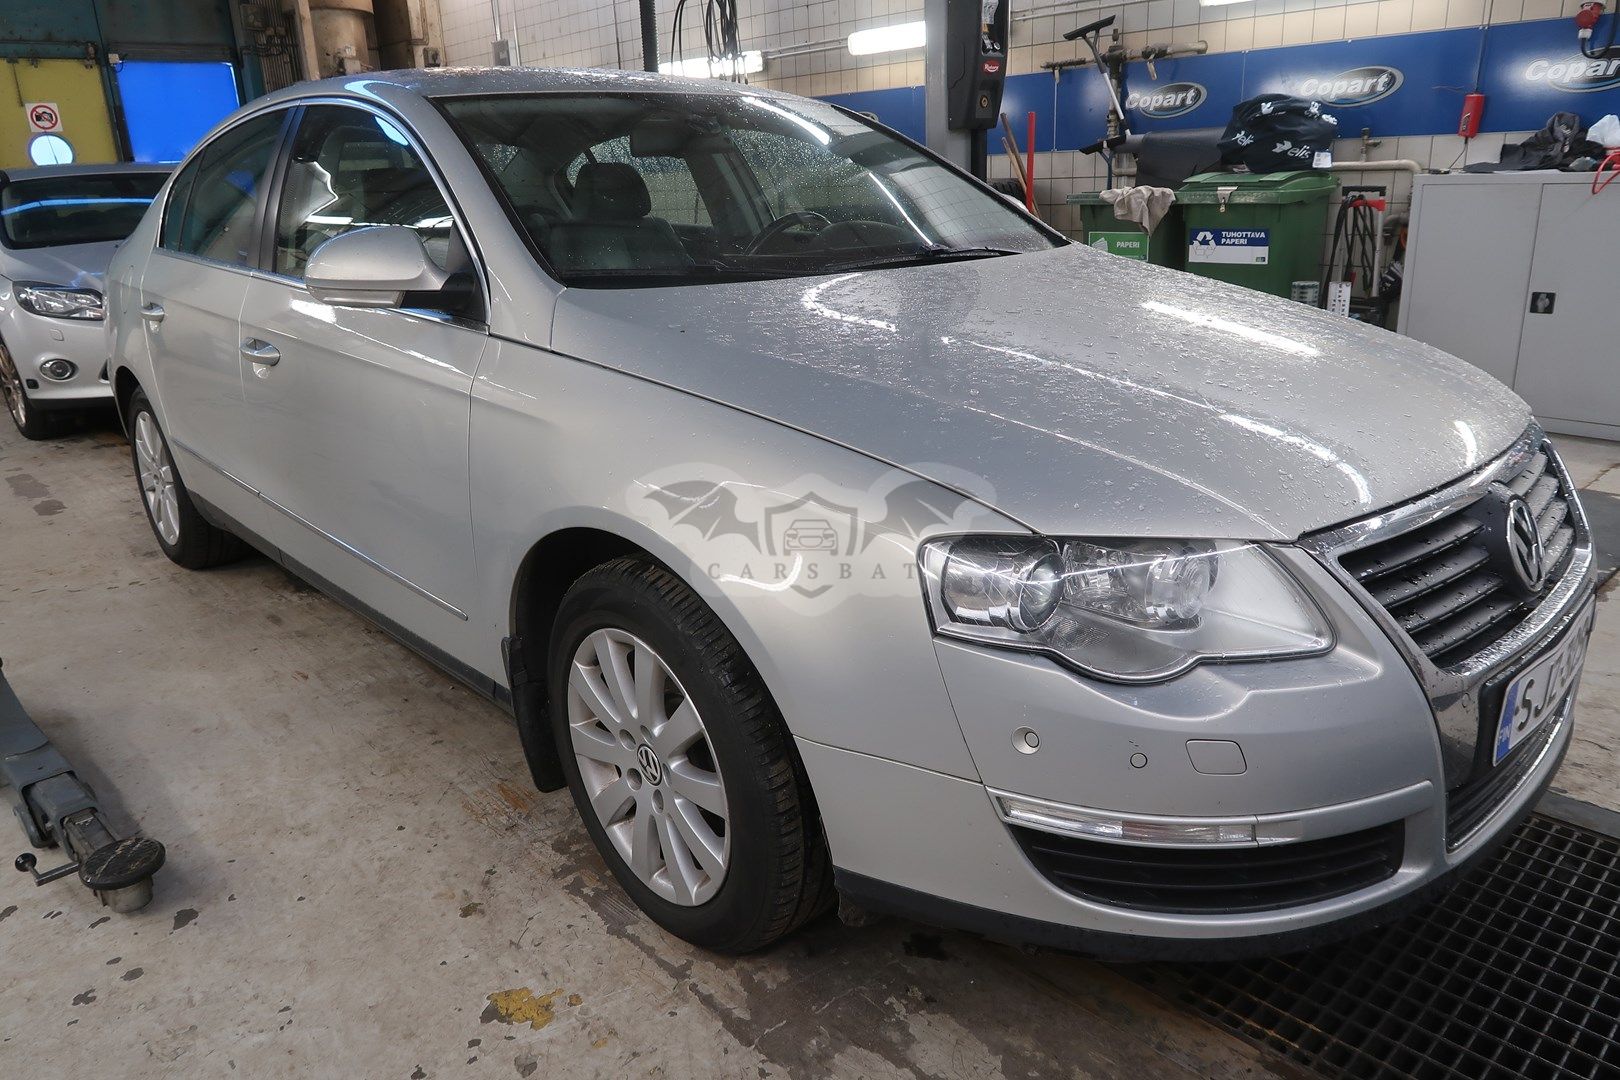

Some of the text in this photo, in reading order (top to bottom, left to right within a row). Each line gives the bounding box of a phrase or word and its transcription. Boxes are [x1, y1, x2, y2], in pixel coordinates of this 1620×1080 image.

[1301, 73, 1389, 100] Copart
[1126, 88, 1195, 111] Copart
[1287, 145, 1311, 159] elis
